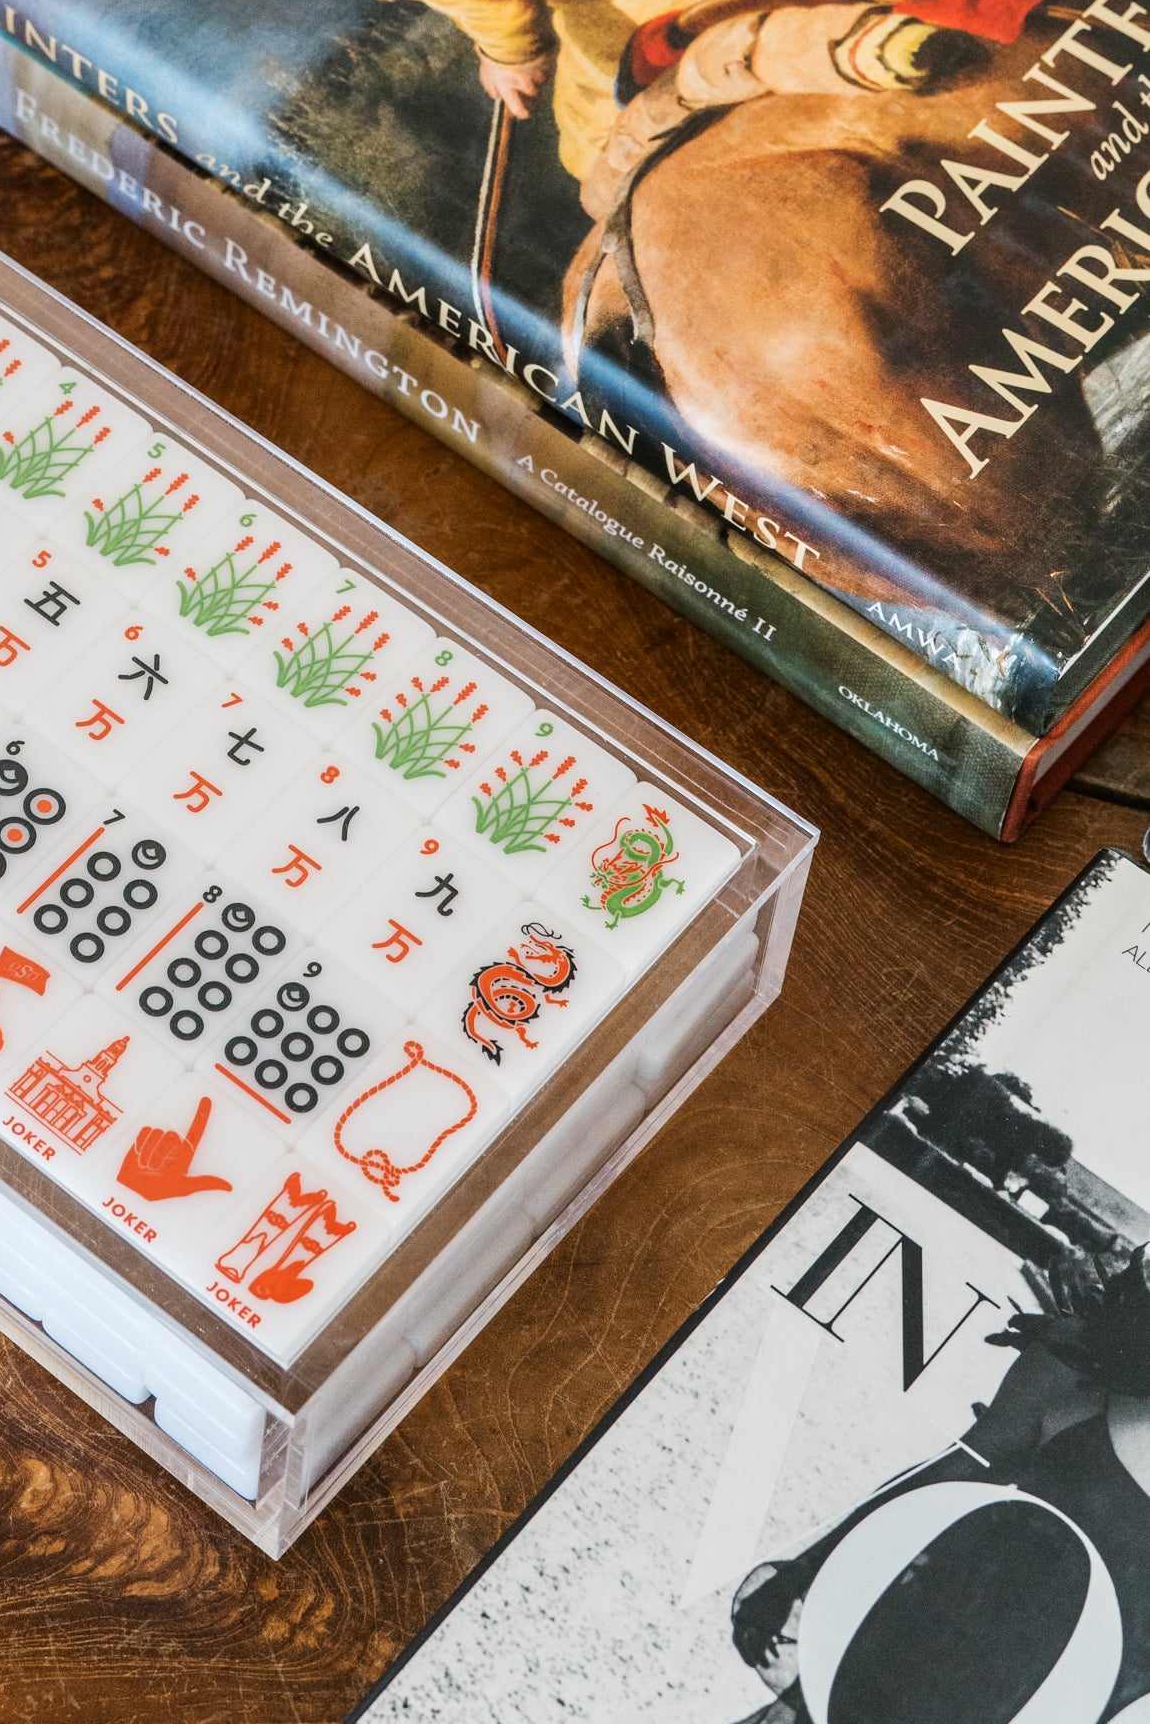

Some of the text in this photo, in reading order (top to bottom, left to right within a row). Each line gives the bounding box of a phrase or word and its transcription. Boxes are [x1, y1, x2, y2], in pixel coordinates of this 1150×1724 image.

[1090, 100, 1149, 181] and
[15, 87, 482, 445] FREDERIC REMINGTON
[920, 170, 1150, 480] AMERI
[195, 151, 272, 205] and
[277, 202, 334, 249] the
[348, 242, 640, 456] AMERICAN
[660, 441, 822, 572] WEST
[58, 381, 77, 395] 4
[147, 442, 167, 459] 5
[239, 513, 258, 528] 6
[515, 454, 778, 642] A Catalogue Raisonné II
[31, 549, 52, 569] 5
[335, 578, 357, 595] 7
[124, 625, 144, 641] 6
[865, 600, 960, 674] AMWA
[434, 649, 454, 667] 8
[221, 692, 244, 709] 7
[535, 722, 554, 737] 9
[837, 685, 940, 763] OKLAHOMA
[5, 739, 26, 756] 6
[319, 765, 341, 785] 8
[102, 808, 126, 826] 7
[419, 838, 440, 856] 9
[202, 884, 223, 904] 8
[302, 961, 323, 978] 9
[2, 1115, 57, 1162] JOKER
[102, 1196, 159, 1244] JOKER
[770, 1193, 1002, 1393] IN
[205, 1281, 263, 1329] JOKER
